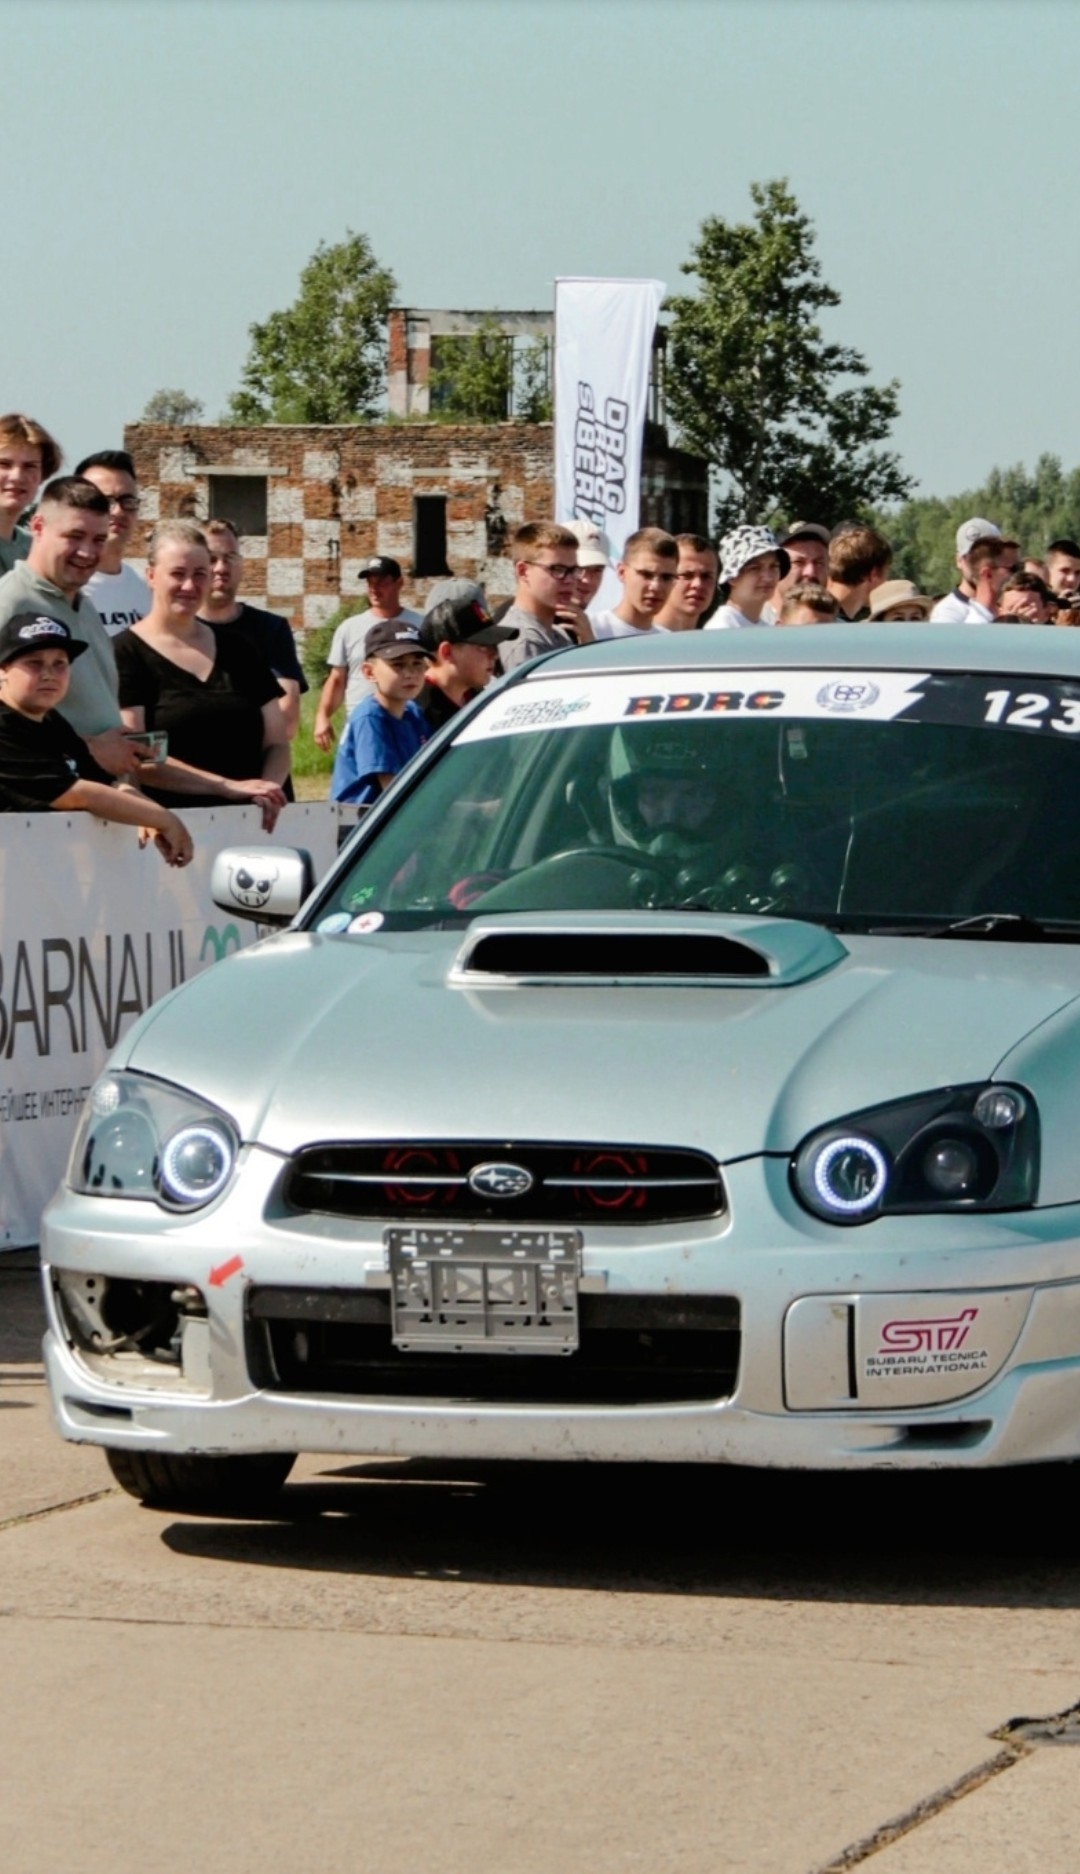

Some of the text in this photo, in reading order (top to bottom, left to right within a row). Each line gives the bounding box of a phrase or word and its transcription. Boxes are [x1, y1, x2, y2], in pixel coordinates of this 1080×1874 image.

[603, 397, 629, 514] DRAG
[623, 690, 786, 716] RDRC
[984, 690, 1080, 733] 123
[866, 1361, 987, 1377] INTERNATIONAL
[867, 1350, 988, 1366] SUBARU TECNICA
